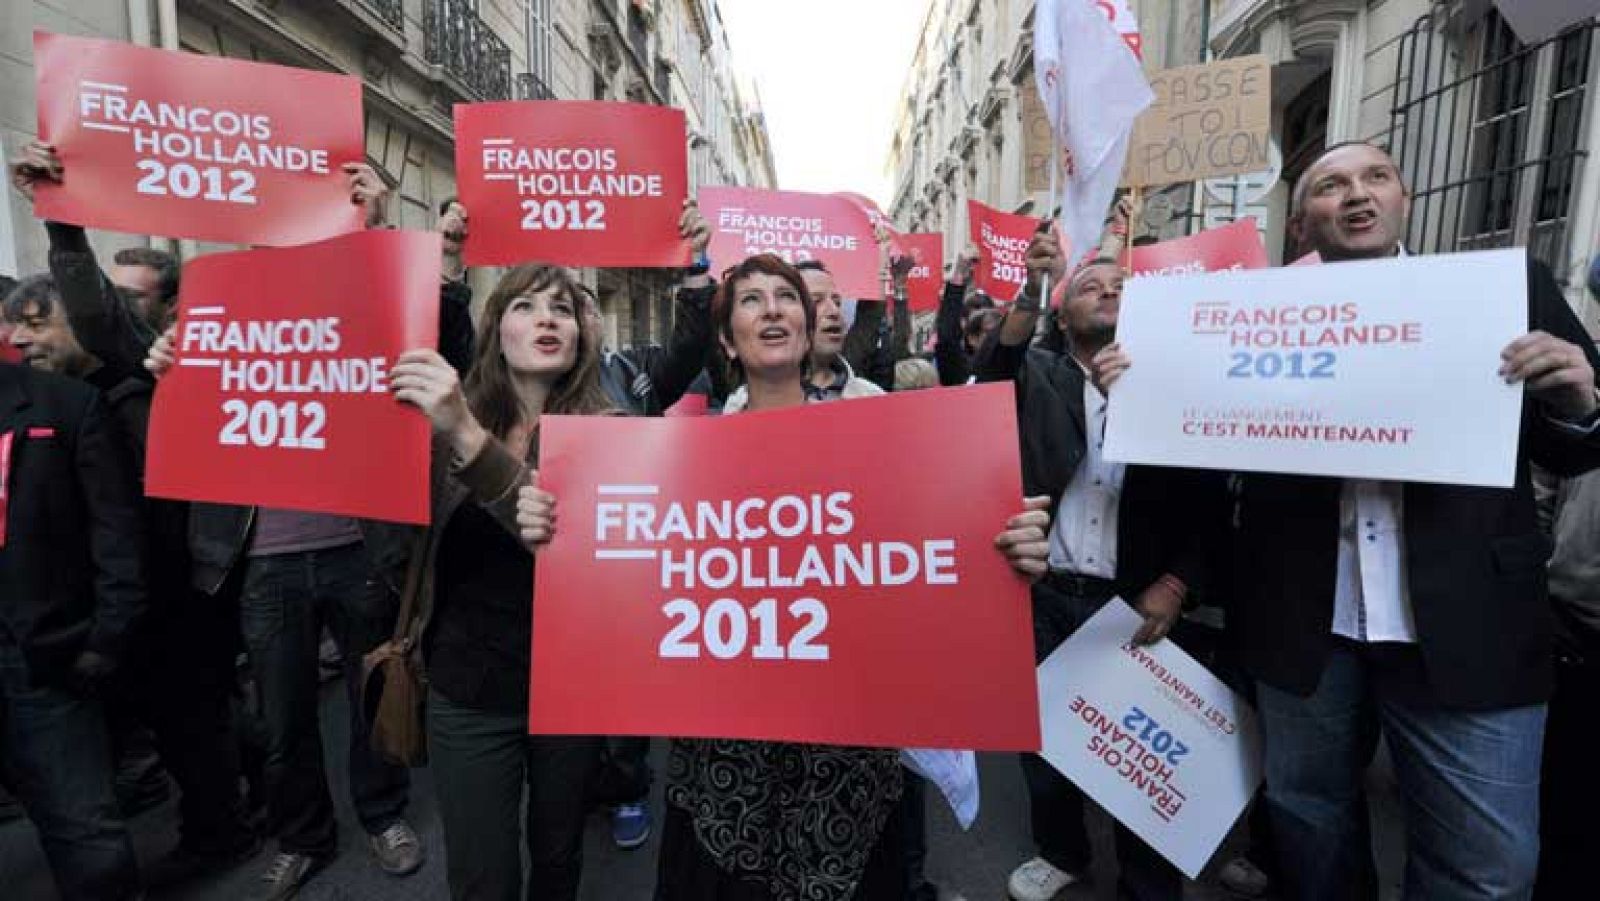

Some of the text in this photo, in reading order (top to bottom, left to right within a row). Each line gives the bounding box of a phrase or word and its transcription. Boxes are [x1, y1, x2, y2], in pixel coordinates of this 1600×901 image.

[133, 128, 330, 175] HOLLANDE
[135, 158, 257, 204] 2012
[517, 174, 662, 196] HOLLANDE
[520, 199, 606, 230] 2012
[743, 230, 858, 251] HOLLANDE
[1229, 323, 1423, 348] HOLLANDE
[220, 356, 390, 393] HOLLANDE
[1227, 350, 1337, 379] 2012
[218, 399, 327, 450] 2012
[1182, 421, 1414, 445] C'EST MAINTENANT
[595, 491, 856, 542] FRANÇOIS
[660, 539, 959, 589] HOLLANDE
[658, 597, 831, 660] 2012
[1068, 695, 1174, 783] HOLLANDE
[1122, 706, 1190, 766] 2012
